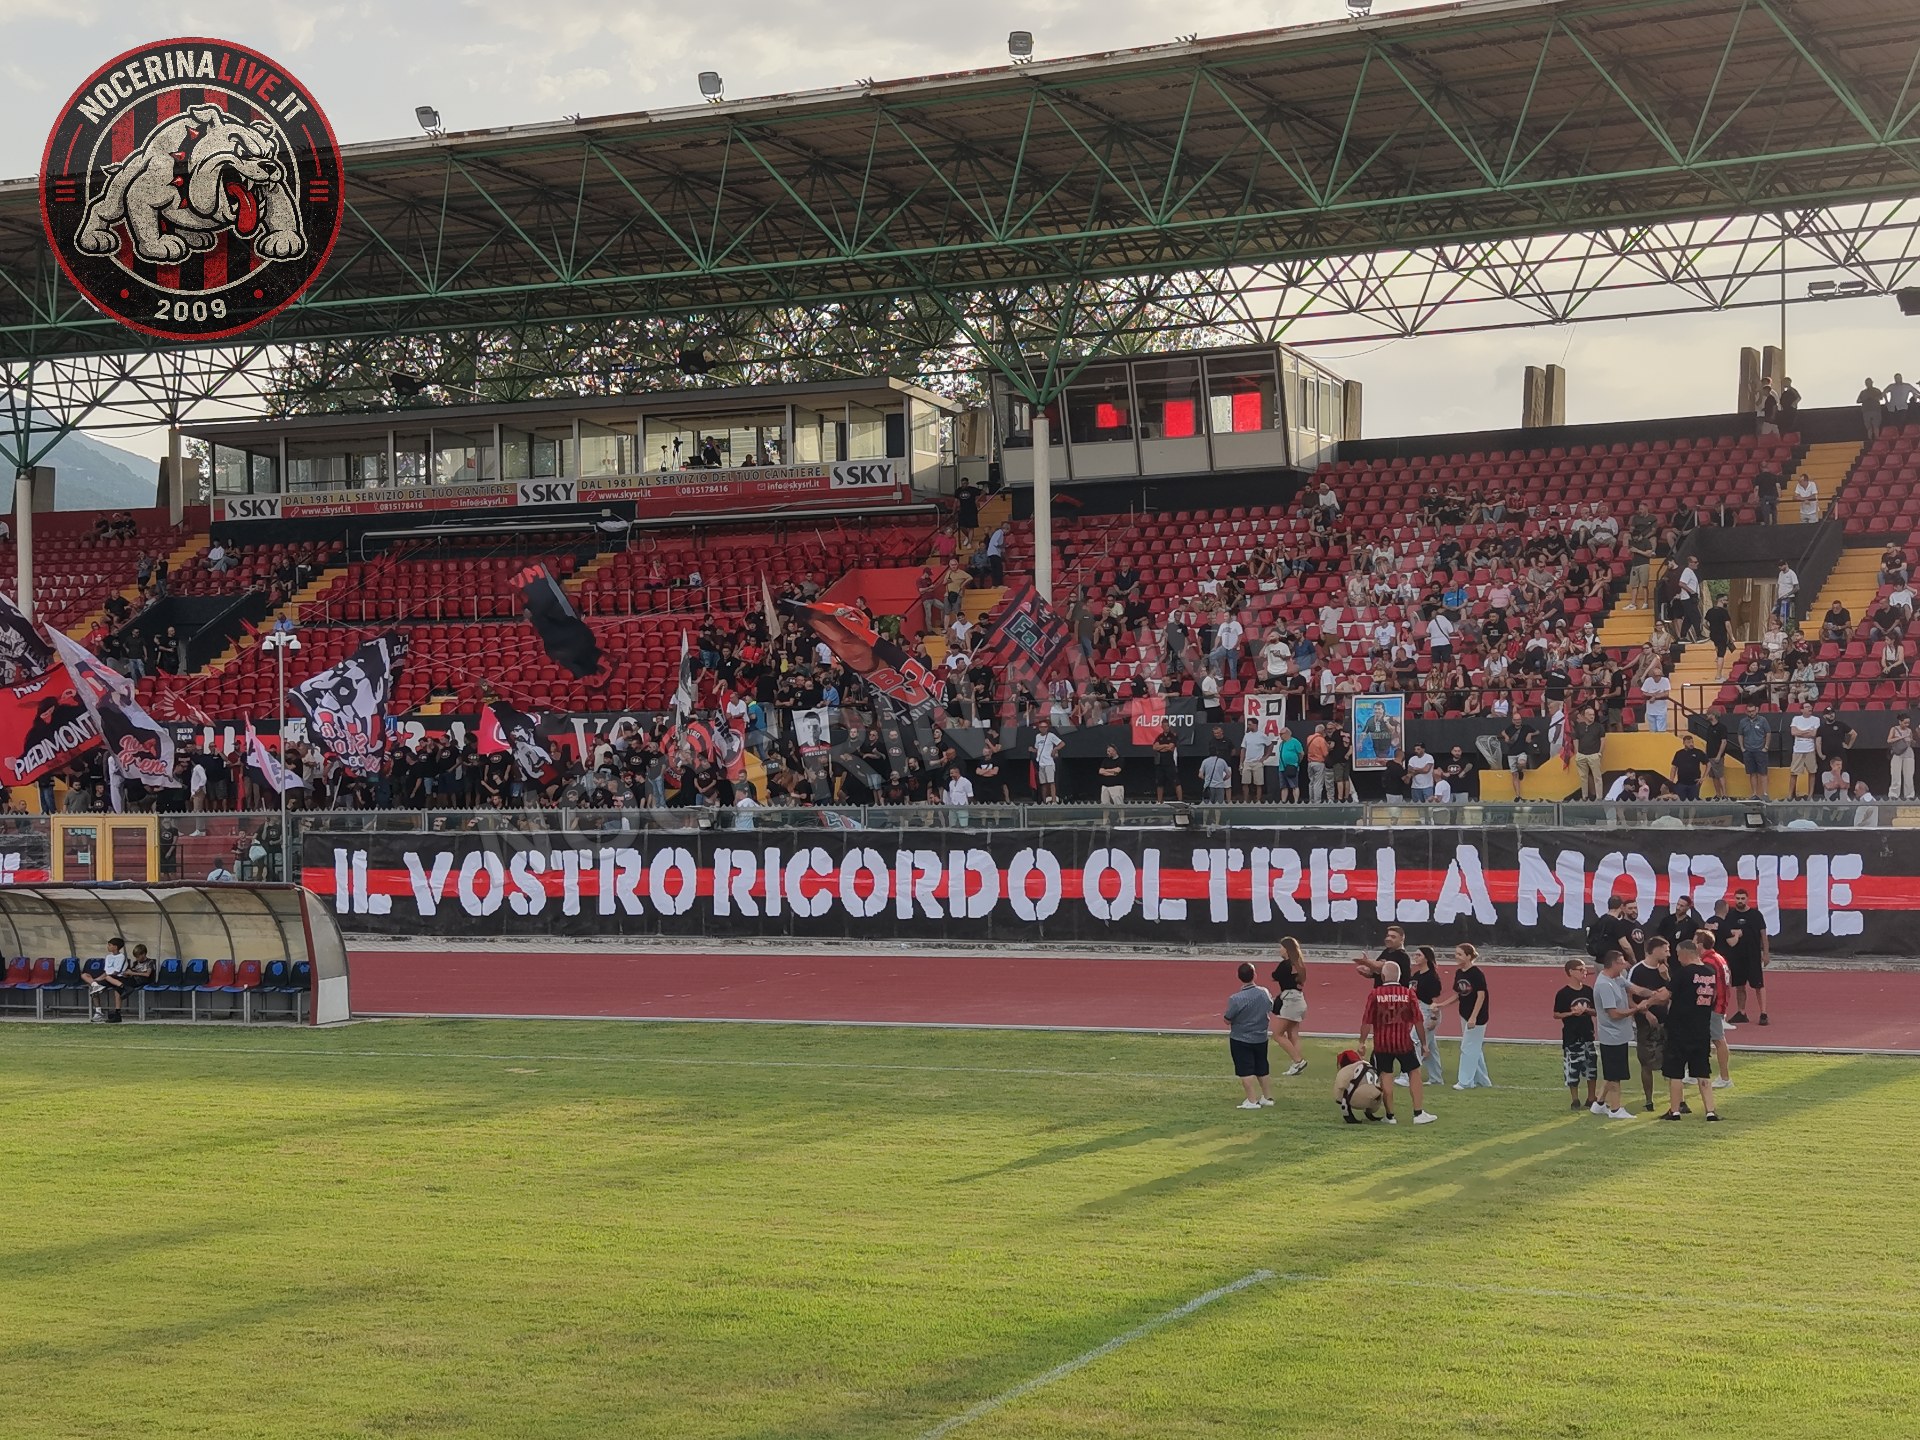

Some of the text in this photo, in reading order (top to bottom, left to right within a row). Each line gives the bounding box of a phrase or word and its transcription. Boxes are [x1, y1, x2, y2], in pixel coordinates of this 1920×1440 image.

[581, 480, 604, 490] DAL
[607, 478, 632, 488] 1981
[637, 476, 652, 487] AL
[655, 474, 708, 486] SERVIZIO
[712, 472, 733, 483] DEL
[736, 470, 760, 481] TUO
[842, 464, 892, 485] SKY
[285, 496, 307, 506] DAL
[310, 495, 334, 505] 1981
[338, 493, 351, 503] AL
[355, 490, 405, 502] SERVIZIO
[408, 489, 428, 499] DEL
[431, 488, 453, 498] TUO
[534, 484, 575, 502] SKY
[598, 489, 652, 501] www.skysrl.it
[240, 498, 279, 518] SKY
[333, 844, 1864, 937] IL VOSTRO RICORDO OLTRE LA MORTE
